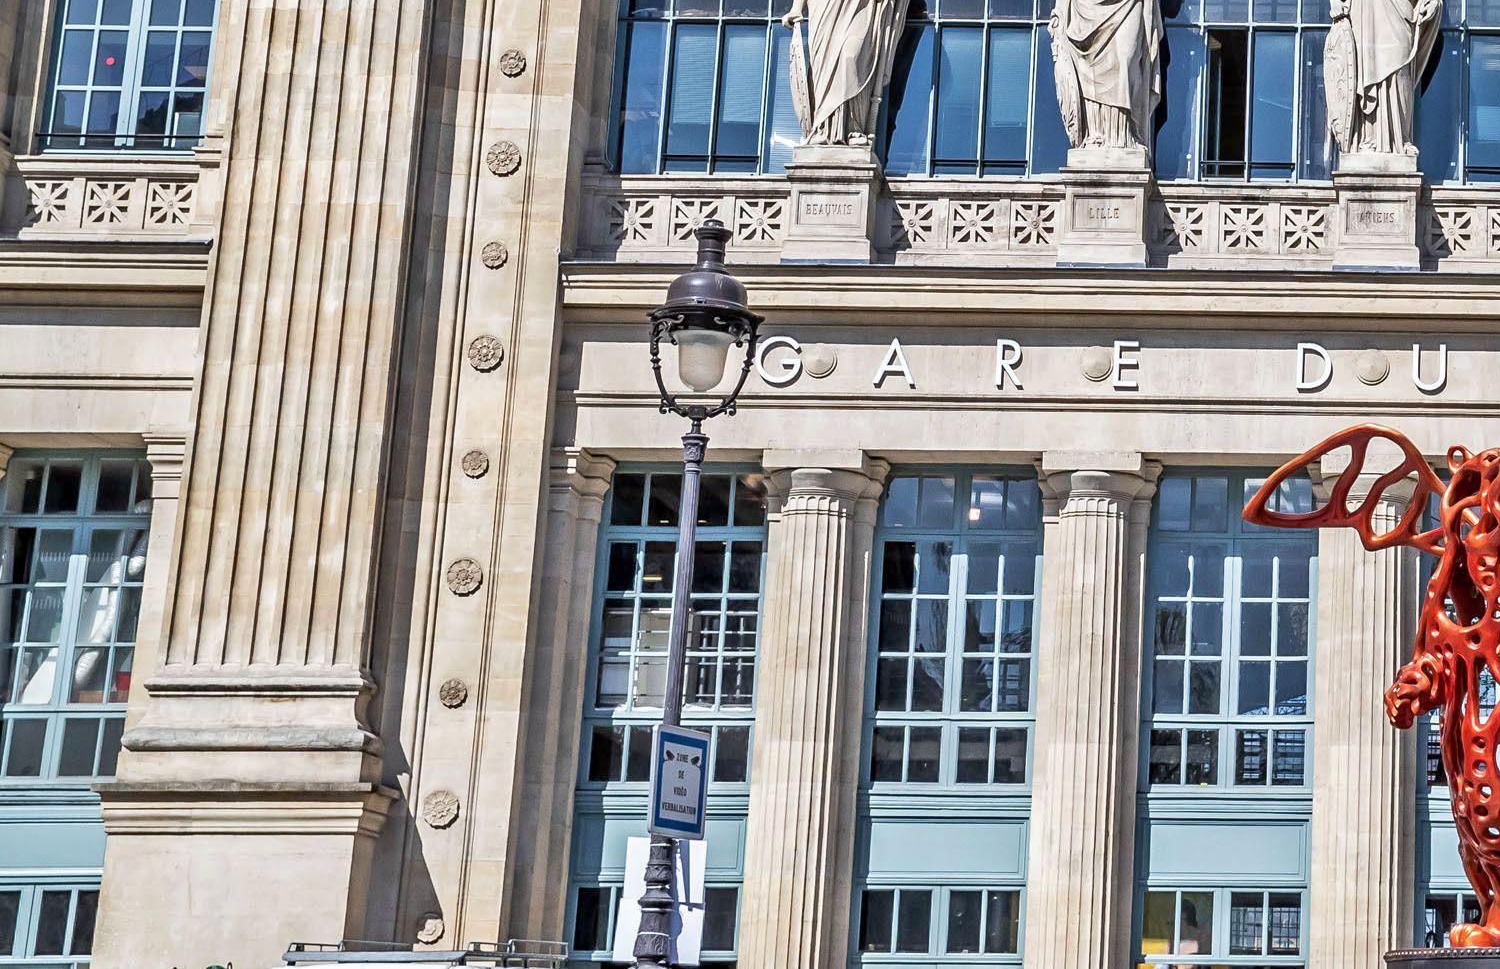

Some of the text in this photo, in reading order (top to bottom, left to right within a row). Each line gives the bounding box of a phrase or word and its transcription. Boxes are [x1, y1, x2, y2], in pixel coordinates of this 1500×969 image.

[806, 203, 853, 216] BEAUVAIS
[1089, 207, 1119, 219] LILLE
[755, 336, 1140, 389] GARE
[1296, 342, 1448, 393] DU
[676, 752, 689, 764] ZONE
[678, 770, 685, 780] DE
